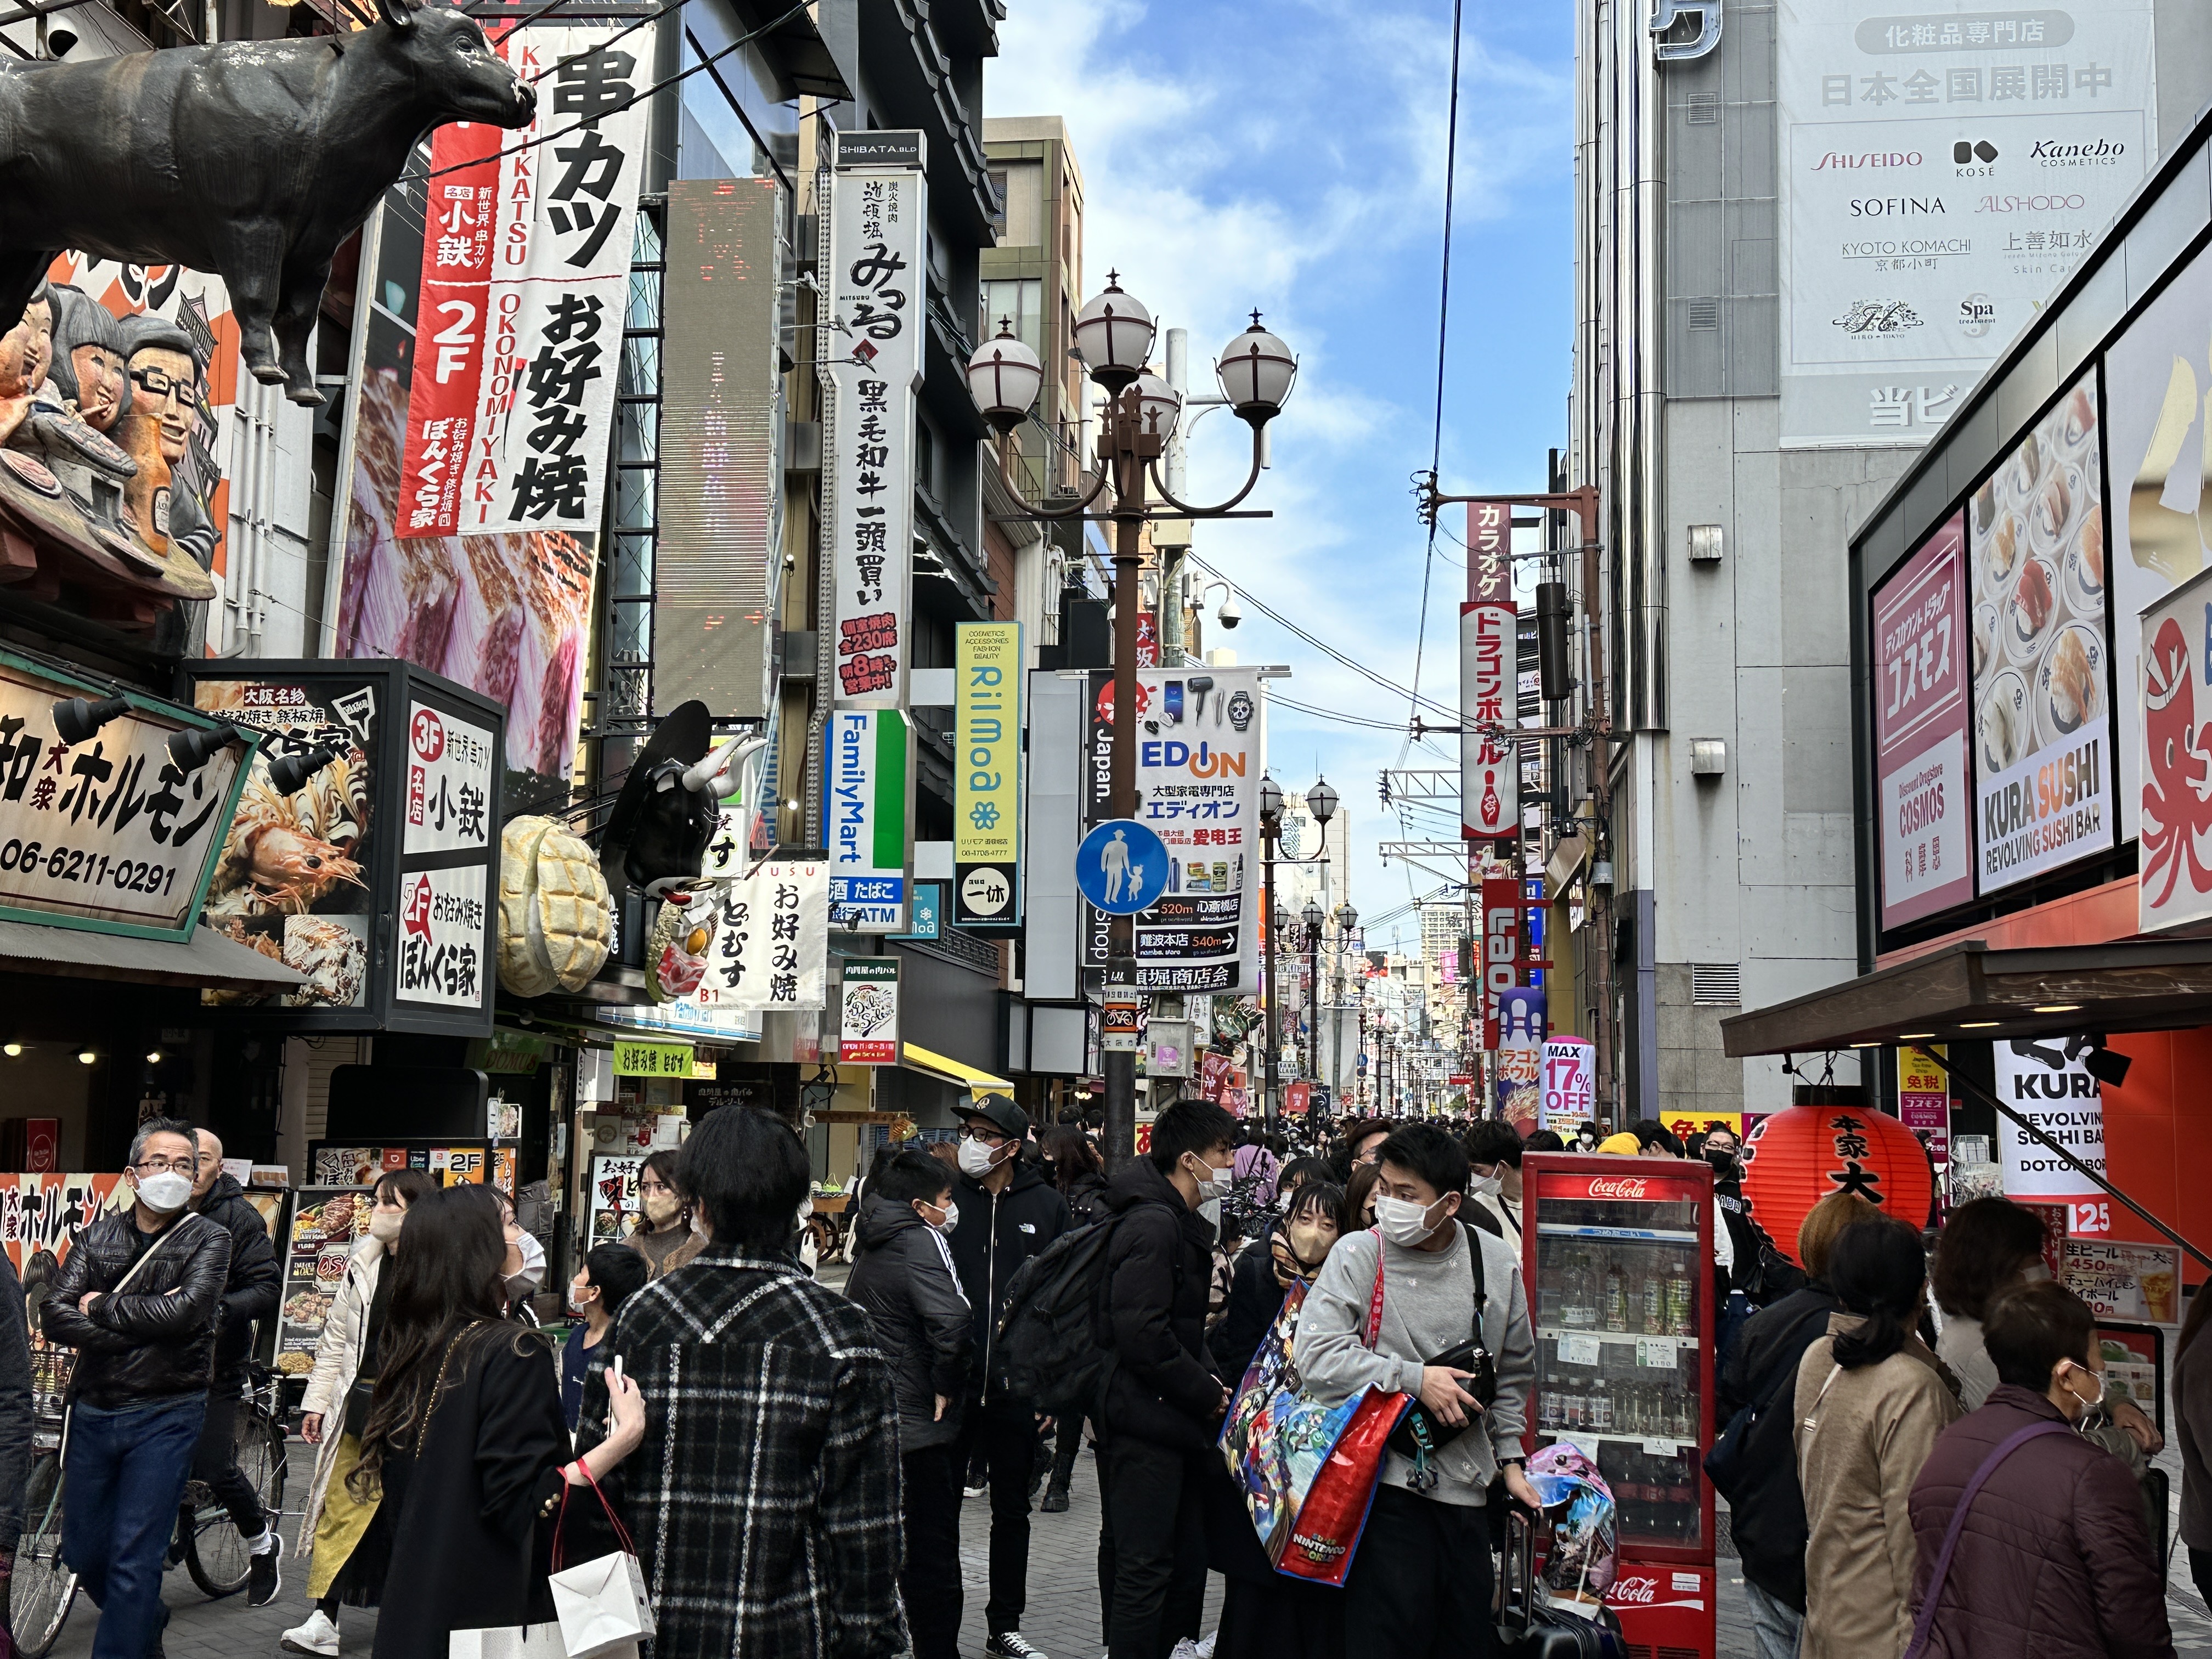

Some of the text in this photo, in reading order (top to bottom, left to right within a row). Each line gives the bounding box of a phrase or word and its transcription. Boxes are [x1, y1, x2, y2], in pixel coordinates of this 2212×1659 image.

[1886, 19, 2045, 48] 化粧品専門店
[1822, 62, 2113, 107] 日本全国展開中
[546, 45, 636, 269] 串カツ
[1810, 151, 1923, 171] SHISEIDO
[2030, 138, 2125, 159] Kanebo
[2040, 157, 2117, 167] COSMETICS
[446, 187, 471, 198] 名店
[888, 181, 899, 223] 炭火焼肉
[1849, 198, 1946, 217] SOFINA
[862, 182, 887, 240] 道頓堀
[436, 200, 476, 268] 小鉄
[1842, 239, 1971, 256] KYOTO KOMACHI
[2002, 230, 2092, 251] 上善如水
[1875, 258, 1939, 272] 京都小町
[2014, 264, 2042, 274] Skin
[850, 242, 907, 340] みつる
[1960, 300, 1994, 320] Spa
[433, 298, 476, 384] 2F
[473, 293, 521, 524] OKONOMIYAKI
[507, 293, 603, 522] お好み焼
[410, 417, 455, 529] ぼんくら家
[855, 379, 889, 606] 黒毛和牛一頭買い
[1477, 505, 1502, 596] カラオケ
[1887, 613, 1951, 720] コスモス
[244, 687, 306, 706] 大阪名物
[1475, 612, 1503, 766] ドラゴンボル
[276, 708, 325, 724] 鉄板焼
[970, 665, 1002, 793] Rilmoa
[415, 714, 440, 754] 3F
[1092, 728, 1114, 803] Japan.
[58, 741, 219, 848] ホルモン
[410, 768, 424, 823] 名店
[835, 715, 867, 864] FamilyMart
[1152, 785, 1234, 798] 大型家電専門店
[1984, 738, 2100, 844] KURA SUSHI
[428, 774, 485, 842] 小鉄
[1146, 799, 1240, 820] エディオン
[1900, 782, 1944, 838] COSMOS
[1985, 802, 2101, 876] REVOLVING SUSHI BAR
[1, 838, 176, 896] 06-6211-0291
[404, 882, 431, 923] 2F
[829, 879, 894, 901] 酒 たばこ
[967, 884, 1005, 904] 一休
[433, 892, 483, 931] お好み焼き
[1160, 903, 1193, 915] 520m
[719, 898, 749, 988] どむす
[769, 883, 800, 1003] お好み焼
[1139, 933, 1189, 947] 難波本店
[1192, 936, 1221, 947] 540m
[400, 935, 477, 997] ぼんくら家
[1548, 1045, 1581, 1058] MAX
[1498, 1064, 1539, 1080] ボウル
[1545, 1058, 1591, 1093] 17%
[1907, 1075, 1939, 1089] 免税
[1545, 1091, 1590, 1111] OFF
[1905, 1099, 1943, 1108] コスモス
[449, 1152, 483, 1173] 2F
[1588, 1177, 1648, 1198] Coca-Cola
[2066, 1243, 2119, 1260] 生ビール
[2070, 1257, 2115, 1272] 450円
[1293, 1533, 1346, 1555] NINTENDO
